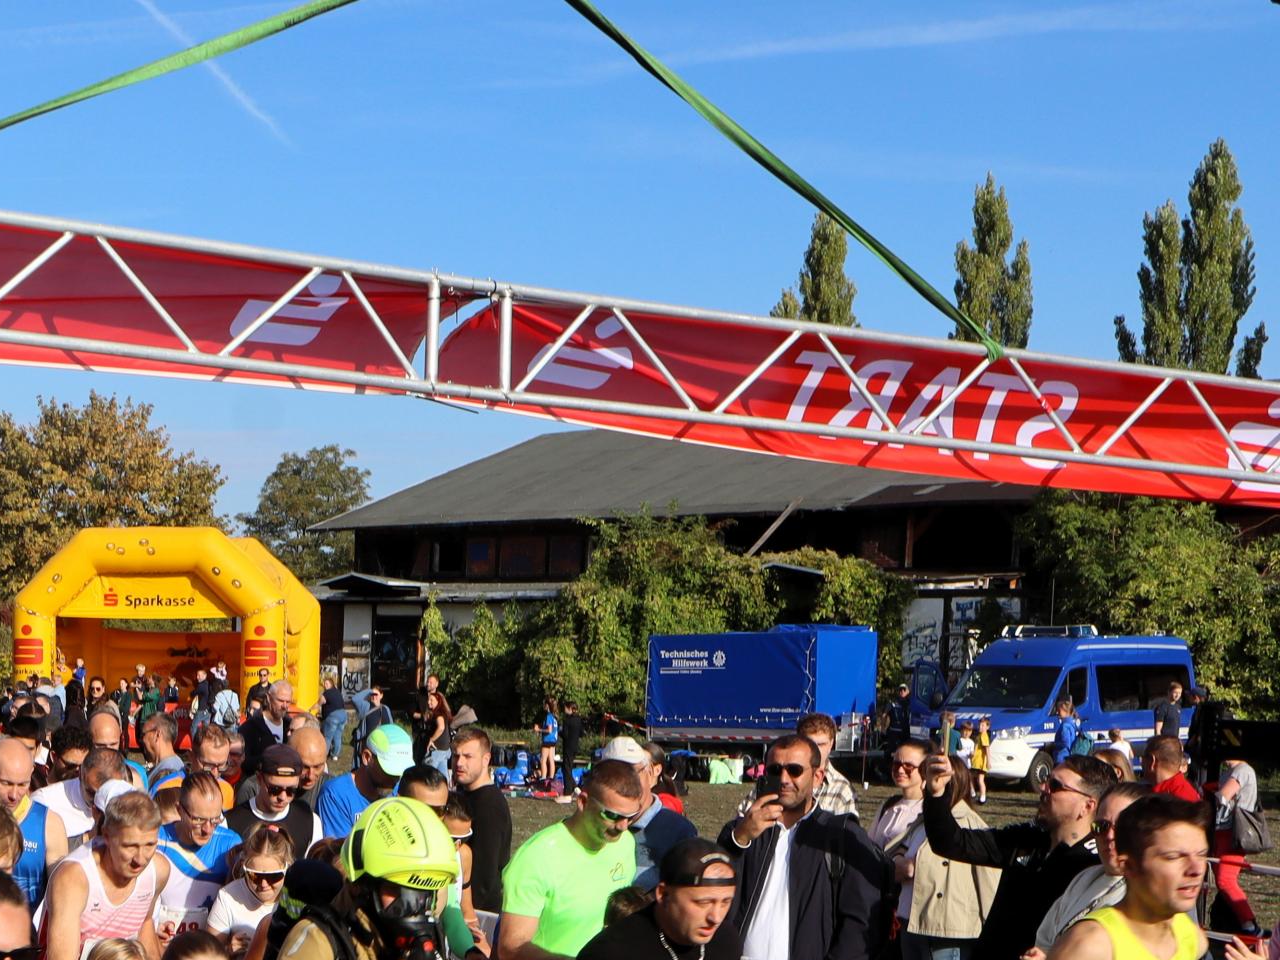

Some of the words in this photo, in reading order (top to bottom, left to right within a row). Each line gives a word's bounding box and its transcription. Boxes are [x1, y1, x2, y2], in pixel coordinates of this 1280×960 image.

[124, 594, 195, 609] Sparkasse
[660, 650, 708, 658] Technisches
[672, 659, 708, 667] Hilfswerk
[23, 839, 38, 849] bau
[407, 873, 449, 888] Bullard
